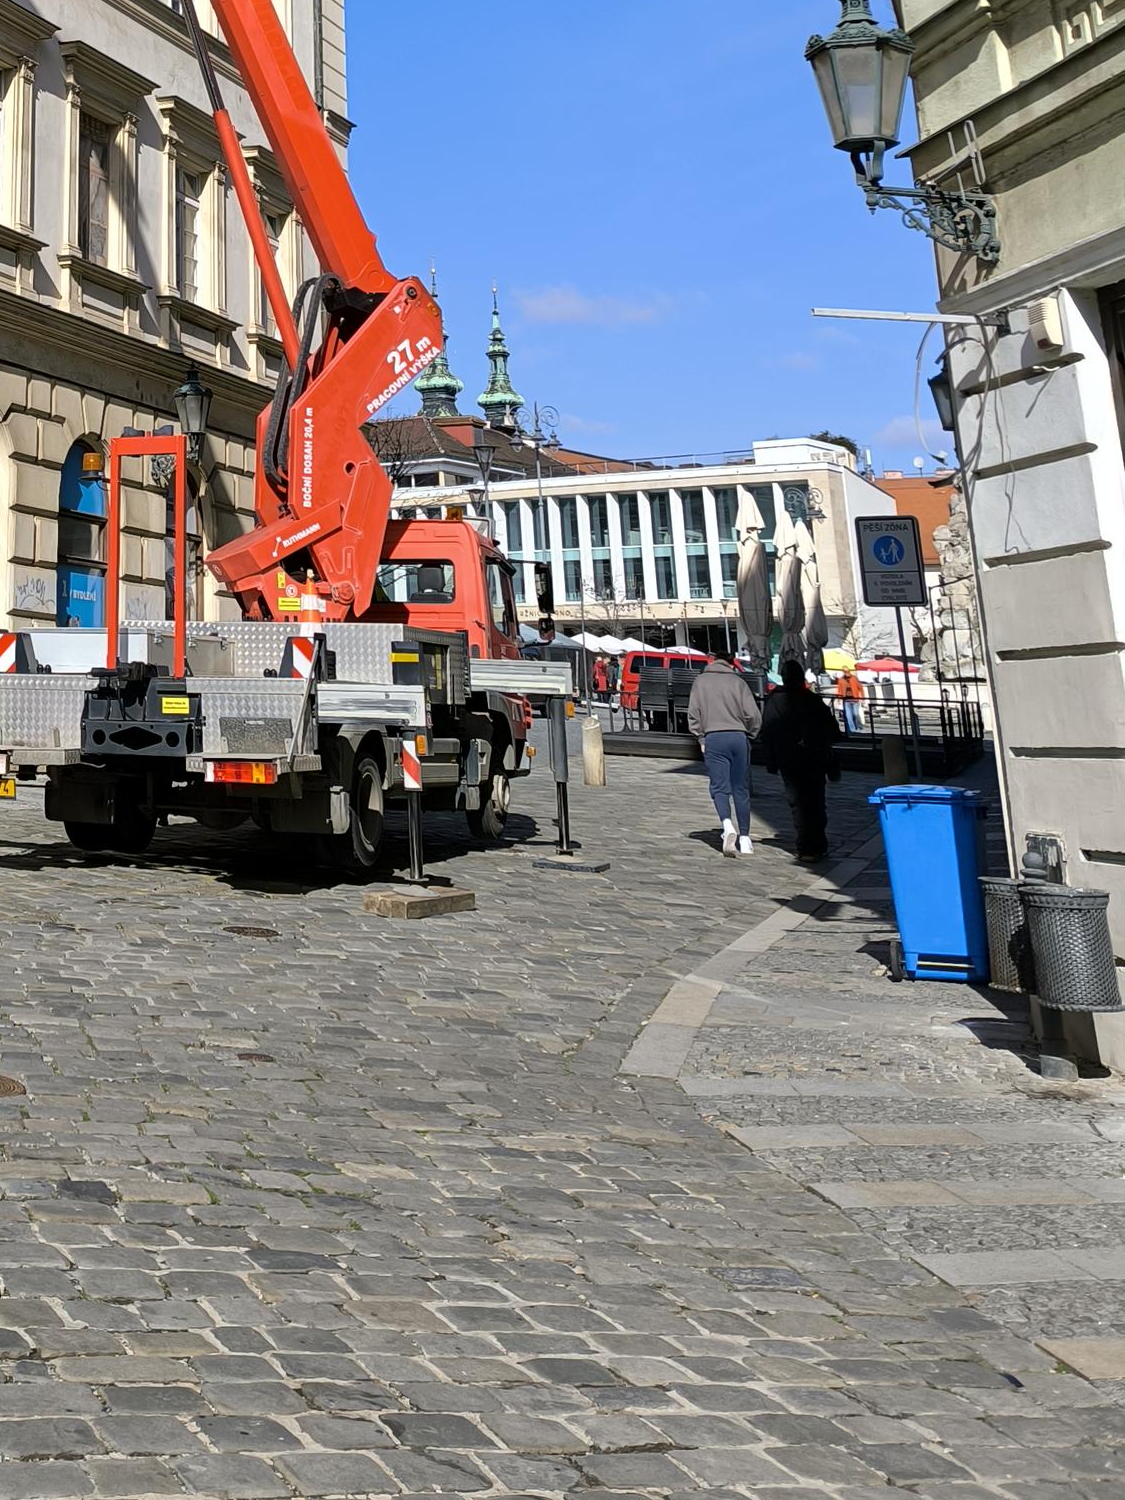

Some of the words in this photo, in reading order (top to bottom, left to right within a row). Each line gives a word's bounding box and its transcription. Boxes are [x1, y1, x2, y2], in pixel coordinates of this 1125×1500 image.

[387, 339, 414, 375] 27
[415, 336, 432, 352] m
[366, 369, 412, 414] PRACOVNÍ
[409, 346, 441, 374] VÝŠKA
[304, 418, 314, 439] 20,4
[303, 441, 313, 474] DOSAH
[302, 476, 312, 508] BOČNÍ
[282, 523, 321, 548] RUTHMANN
[863, 522, 883, 532] PĚŠÍ
[884, 522, 909, 531] ZÓNA
